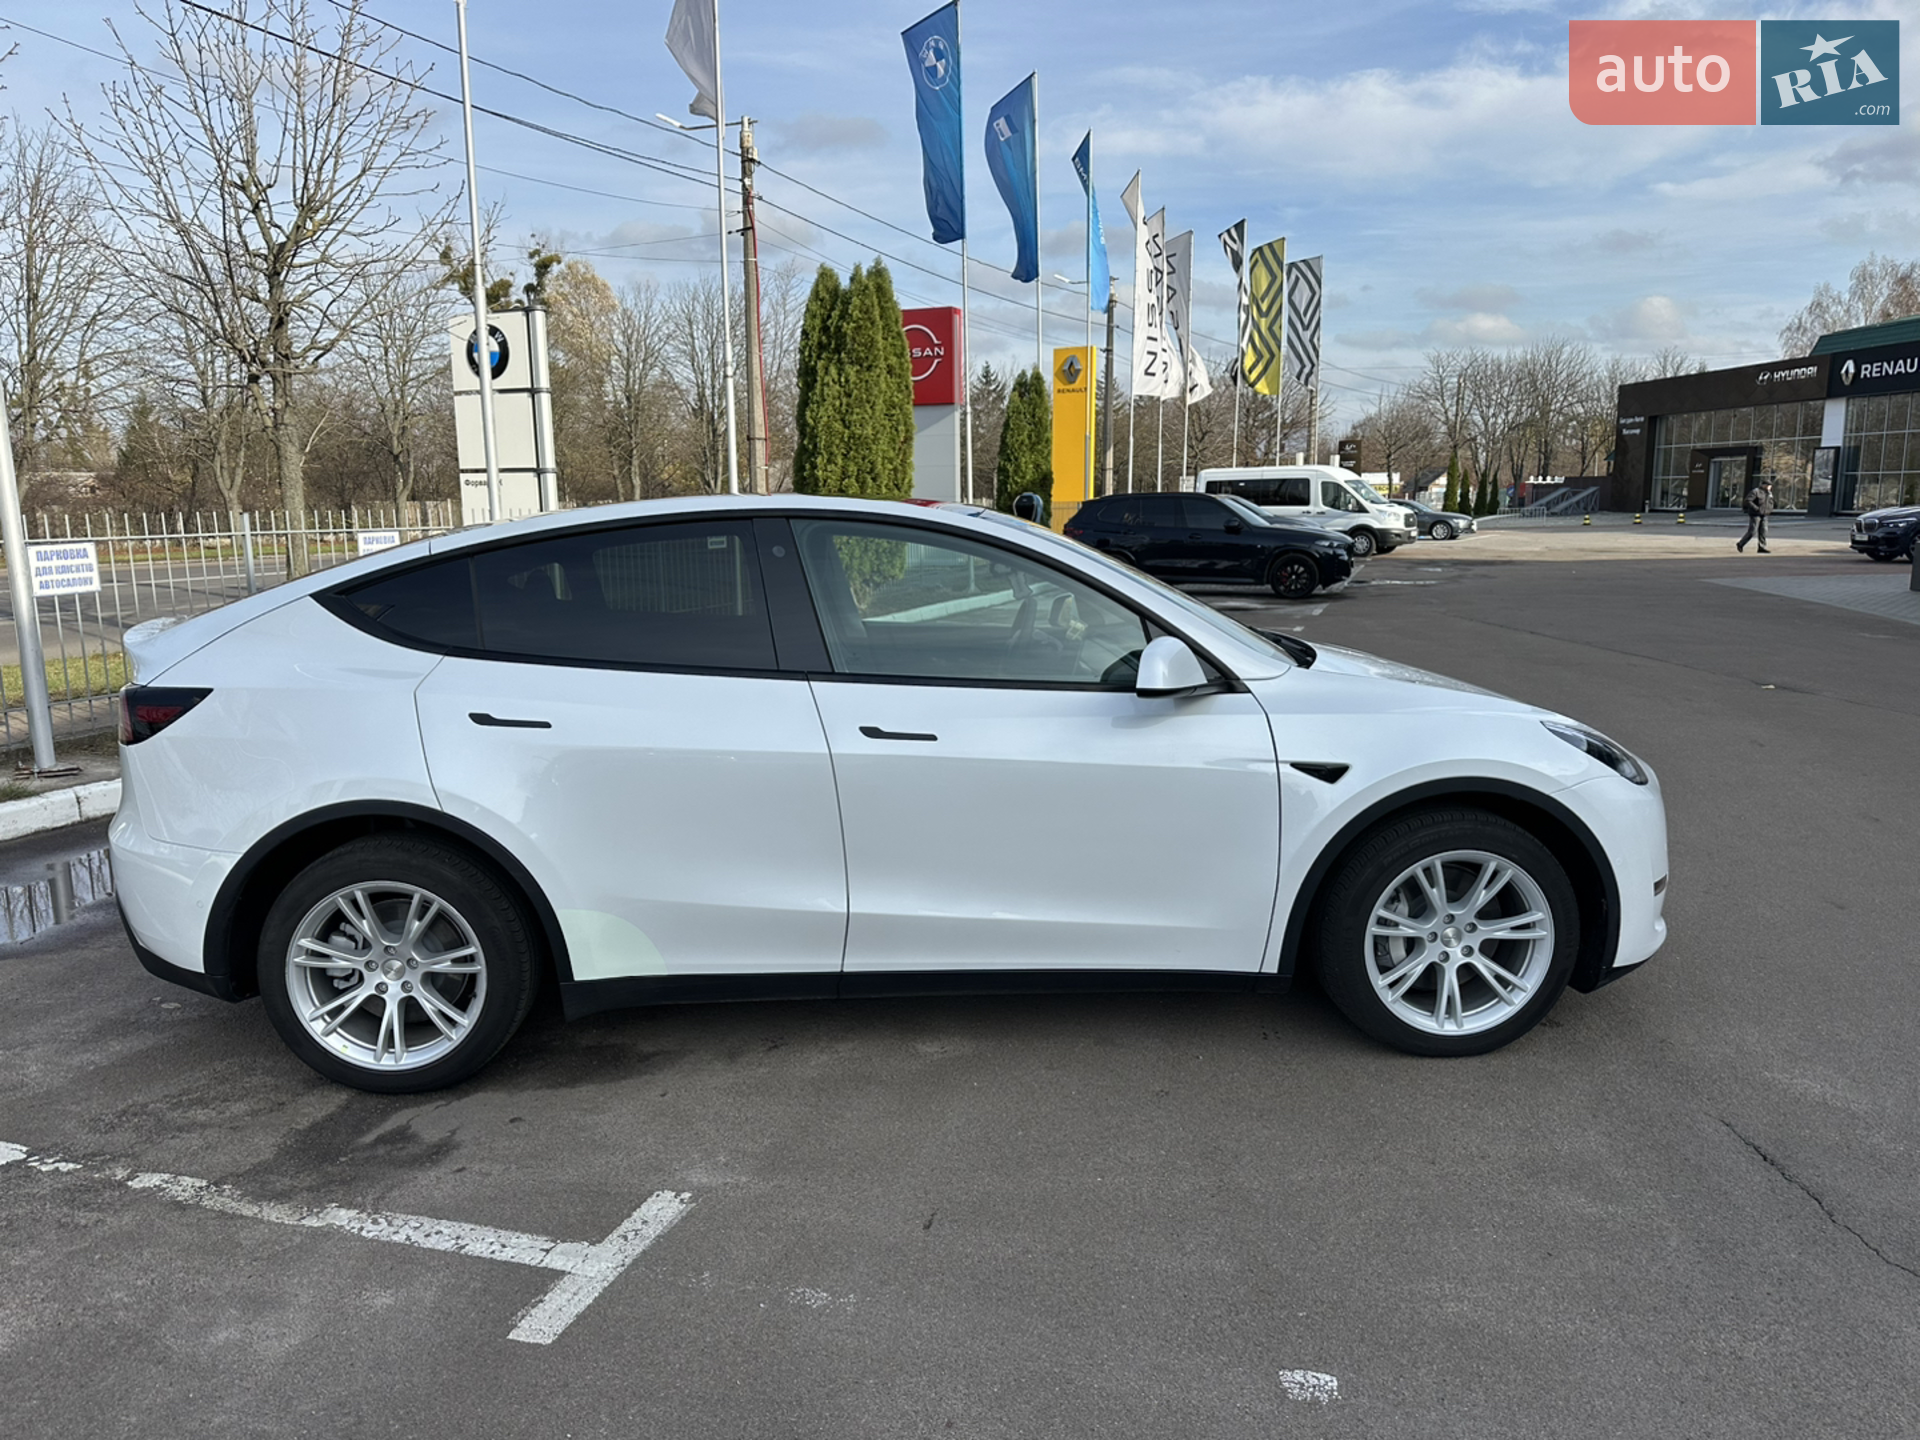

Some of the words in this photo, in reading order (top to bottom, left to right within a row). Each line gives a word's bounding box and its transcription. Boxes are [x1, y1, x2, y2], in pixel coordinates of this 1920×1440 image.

[1773, 365, 1818, 383] HYUNDAI
[1860, 357, 1920, 379] RENAU
[35, 547, 89, 562] ПАРКОВКА
[35, 565, 54, 578] ДЛЯ
[55, 562, 94, 575] КЛІЄНТІВ
[39, 576, 94, 590] АВТОСАЛОНУ
